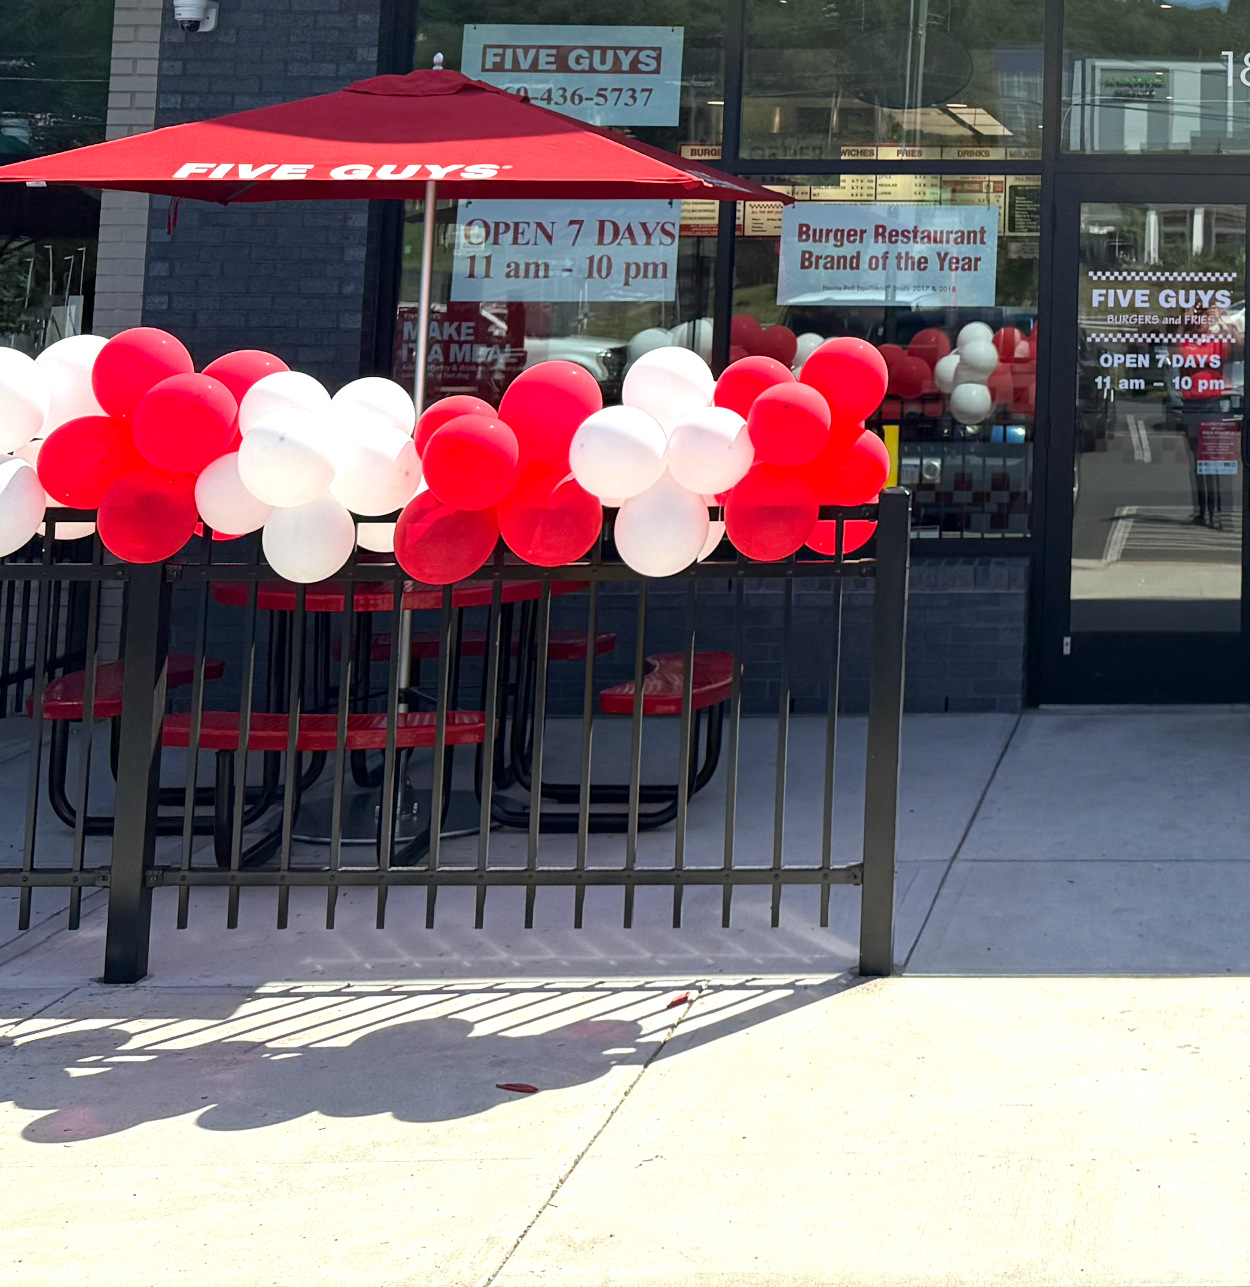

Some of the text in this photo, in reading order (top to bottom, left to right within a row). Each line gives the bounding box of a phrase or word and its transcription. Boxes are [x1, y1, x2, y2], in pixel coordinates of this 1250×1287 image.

[484, 47, 658, 71] FIVE GUYS
[896, 149, 923, 157] FRIES
[957, 149, 990, 157] DRINKS
[172, 163, 500, 181] FIVE GUYS
[464, 218, 676, 246] OPEN 7 DAYS
[797, 223, 867, 248] Burger
[874, 224, 987, 245] Restaurant
[466, 254, 493, 278] 11
[505, 261, 550, 279] am
[585, 254, 613, 279] 10
[623, 261, 668, 287] pm
[800, 250, 982, 272] Brand of the Year
[1092, 289, 1232, 309] FIVE GUYS
[1107, 315, 1216, 325] BURGERS and FRIES
[403, 321, 476, 341] MAKE
[1100, 353, 1221, 368] OPEN 7 DAYS
[1095, 376, 1111, 390] 11
[1118, 379, 1145, 390] am
[1172, 376, 1193, 390] 10
[1197, 379, 1225, 393] pm
